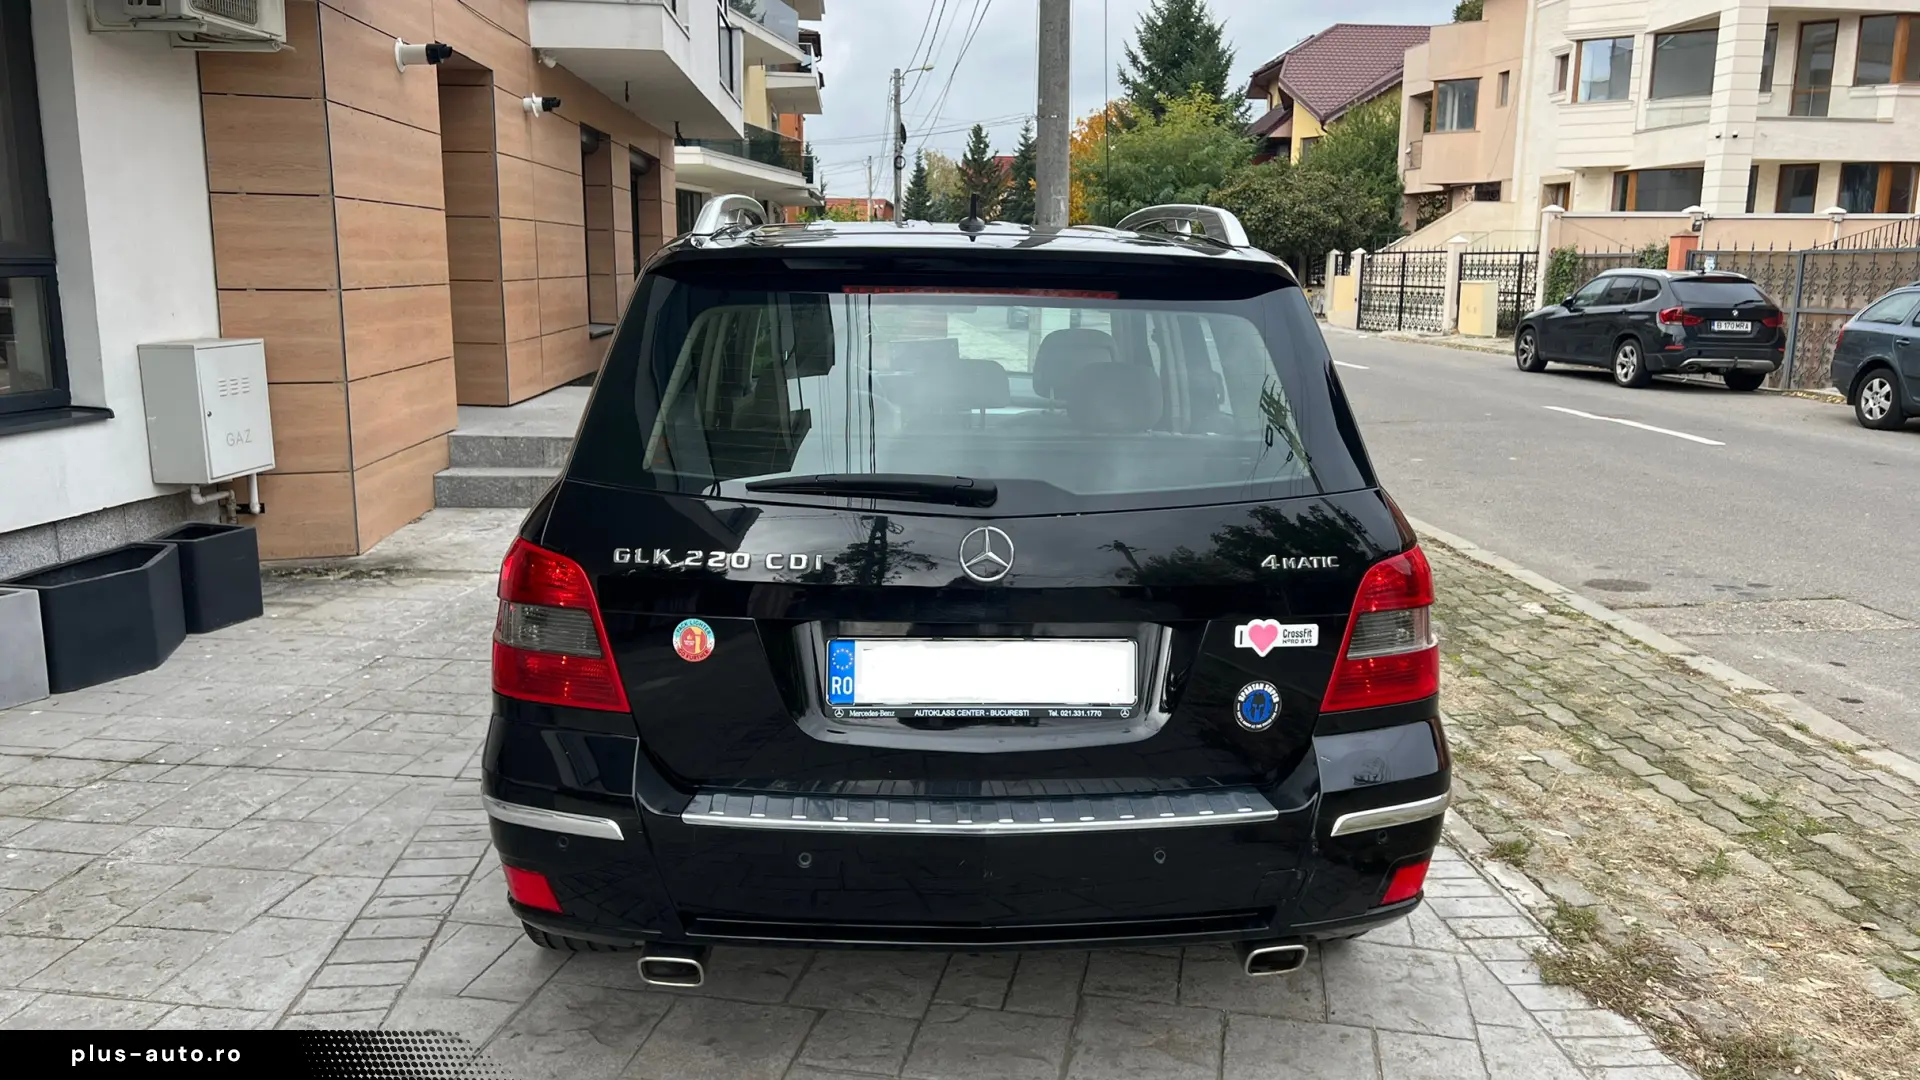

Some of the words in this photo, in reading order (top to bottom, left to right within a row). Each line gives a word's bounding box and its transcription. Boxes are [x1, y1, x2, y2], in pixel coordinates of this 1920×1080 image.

[226, 428, 253, 447] GAZ
[613, 548, 672, 565] GLK
[684, 550, 751, 569] 220
[765, 553, 824, 571] CDI
[1261, 554, 1340, 570] 4MATIC
[1282, 628, 1313, 638] CrossFit
[831, 676, 853, 695] RO
[849, 709, 895, 717] Mercedes-Benz
[914, 709, 956, 717] AUTOKLASS
[956, 709, 985, 717] CENTER
[990, 709, 1030, 717] BUCURESTI
[1048, 709, 1059, 717] Tel.
[1060, 709, 1102, 717] 021.331.1770
